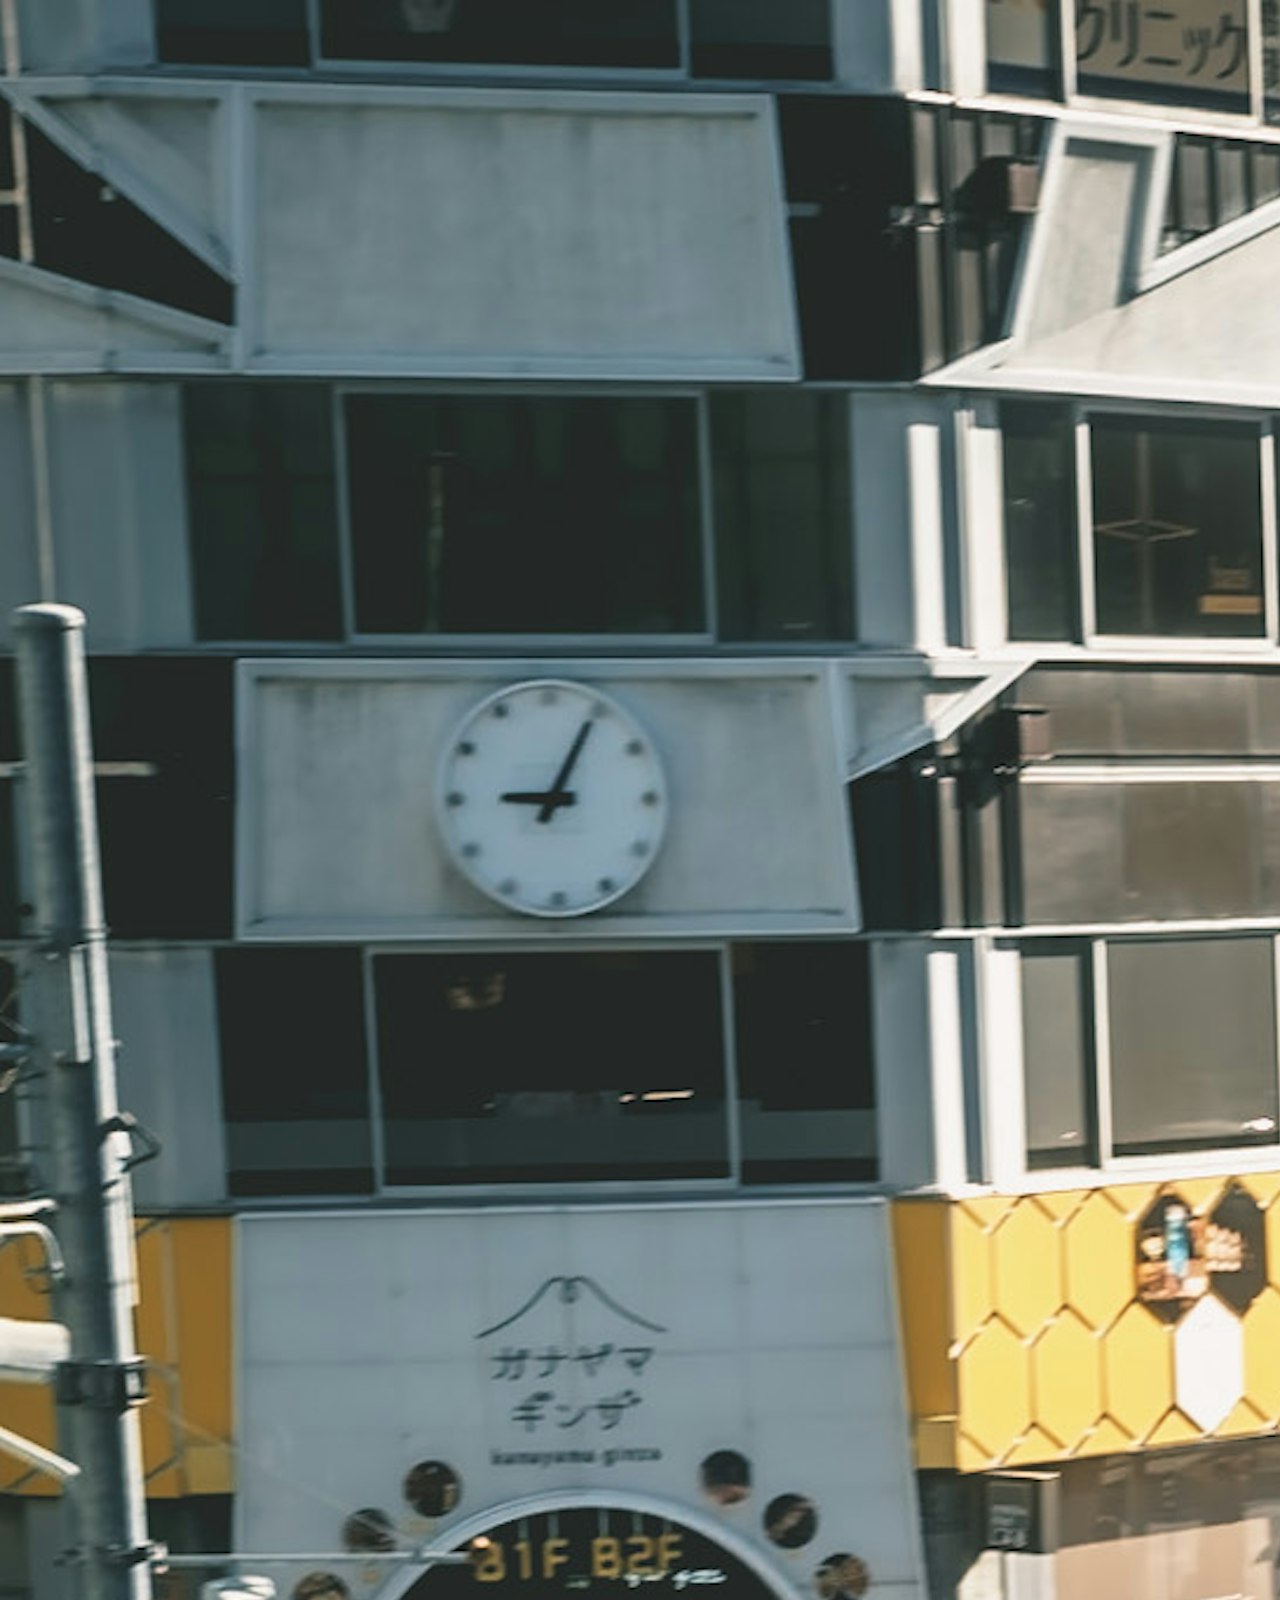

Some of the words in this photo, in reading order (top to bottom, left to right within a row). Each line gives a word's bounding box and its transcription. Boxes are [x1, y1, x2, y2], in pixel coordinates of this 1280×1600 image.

[490, 1343, 654, 1382] カナヤマ
[511, 1388, 643, 1433] ギンザ
[592, 1533, 684, 1579] B2F
